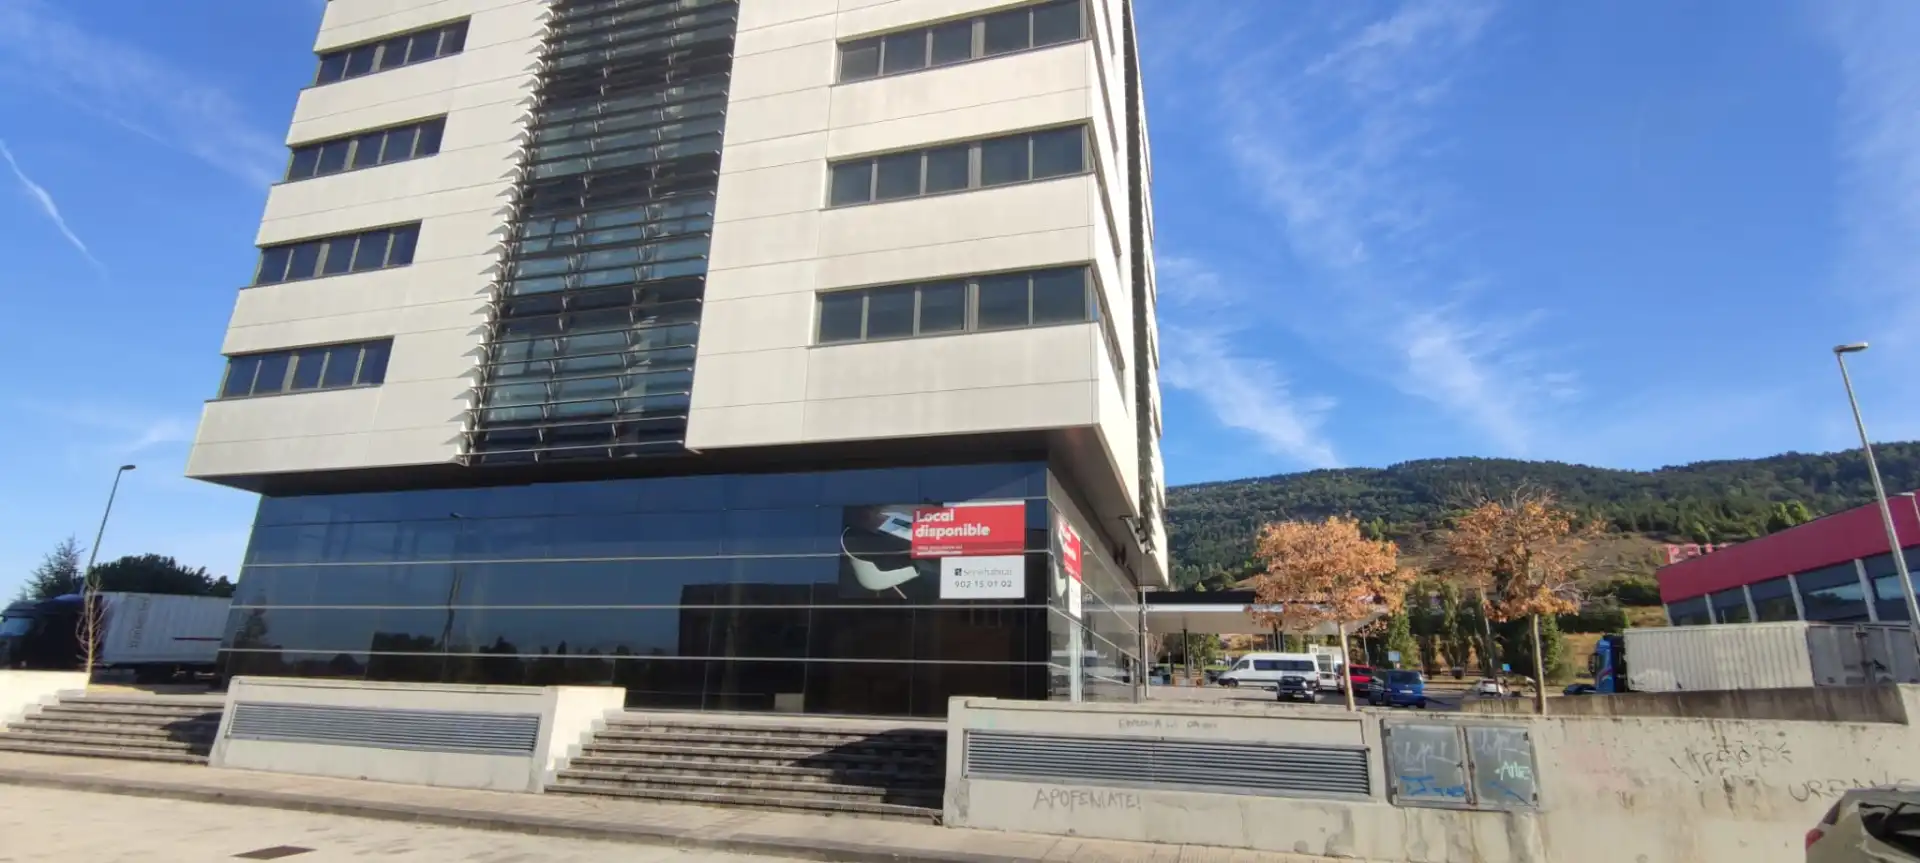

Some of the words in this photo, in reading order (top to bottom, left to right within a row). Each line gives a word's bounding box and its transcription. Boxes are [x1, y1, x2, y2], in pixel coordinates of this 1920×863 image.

[916, 508, 954, 522] Local
[915, 523, 990, 540] disponible
[954, 580, 972, 588] 902
[974, 580, 984, 588] 15
[987, 580, 998, 588] 01
[1001, 579, 1013, 588] 02
